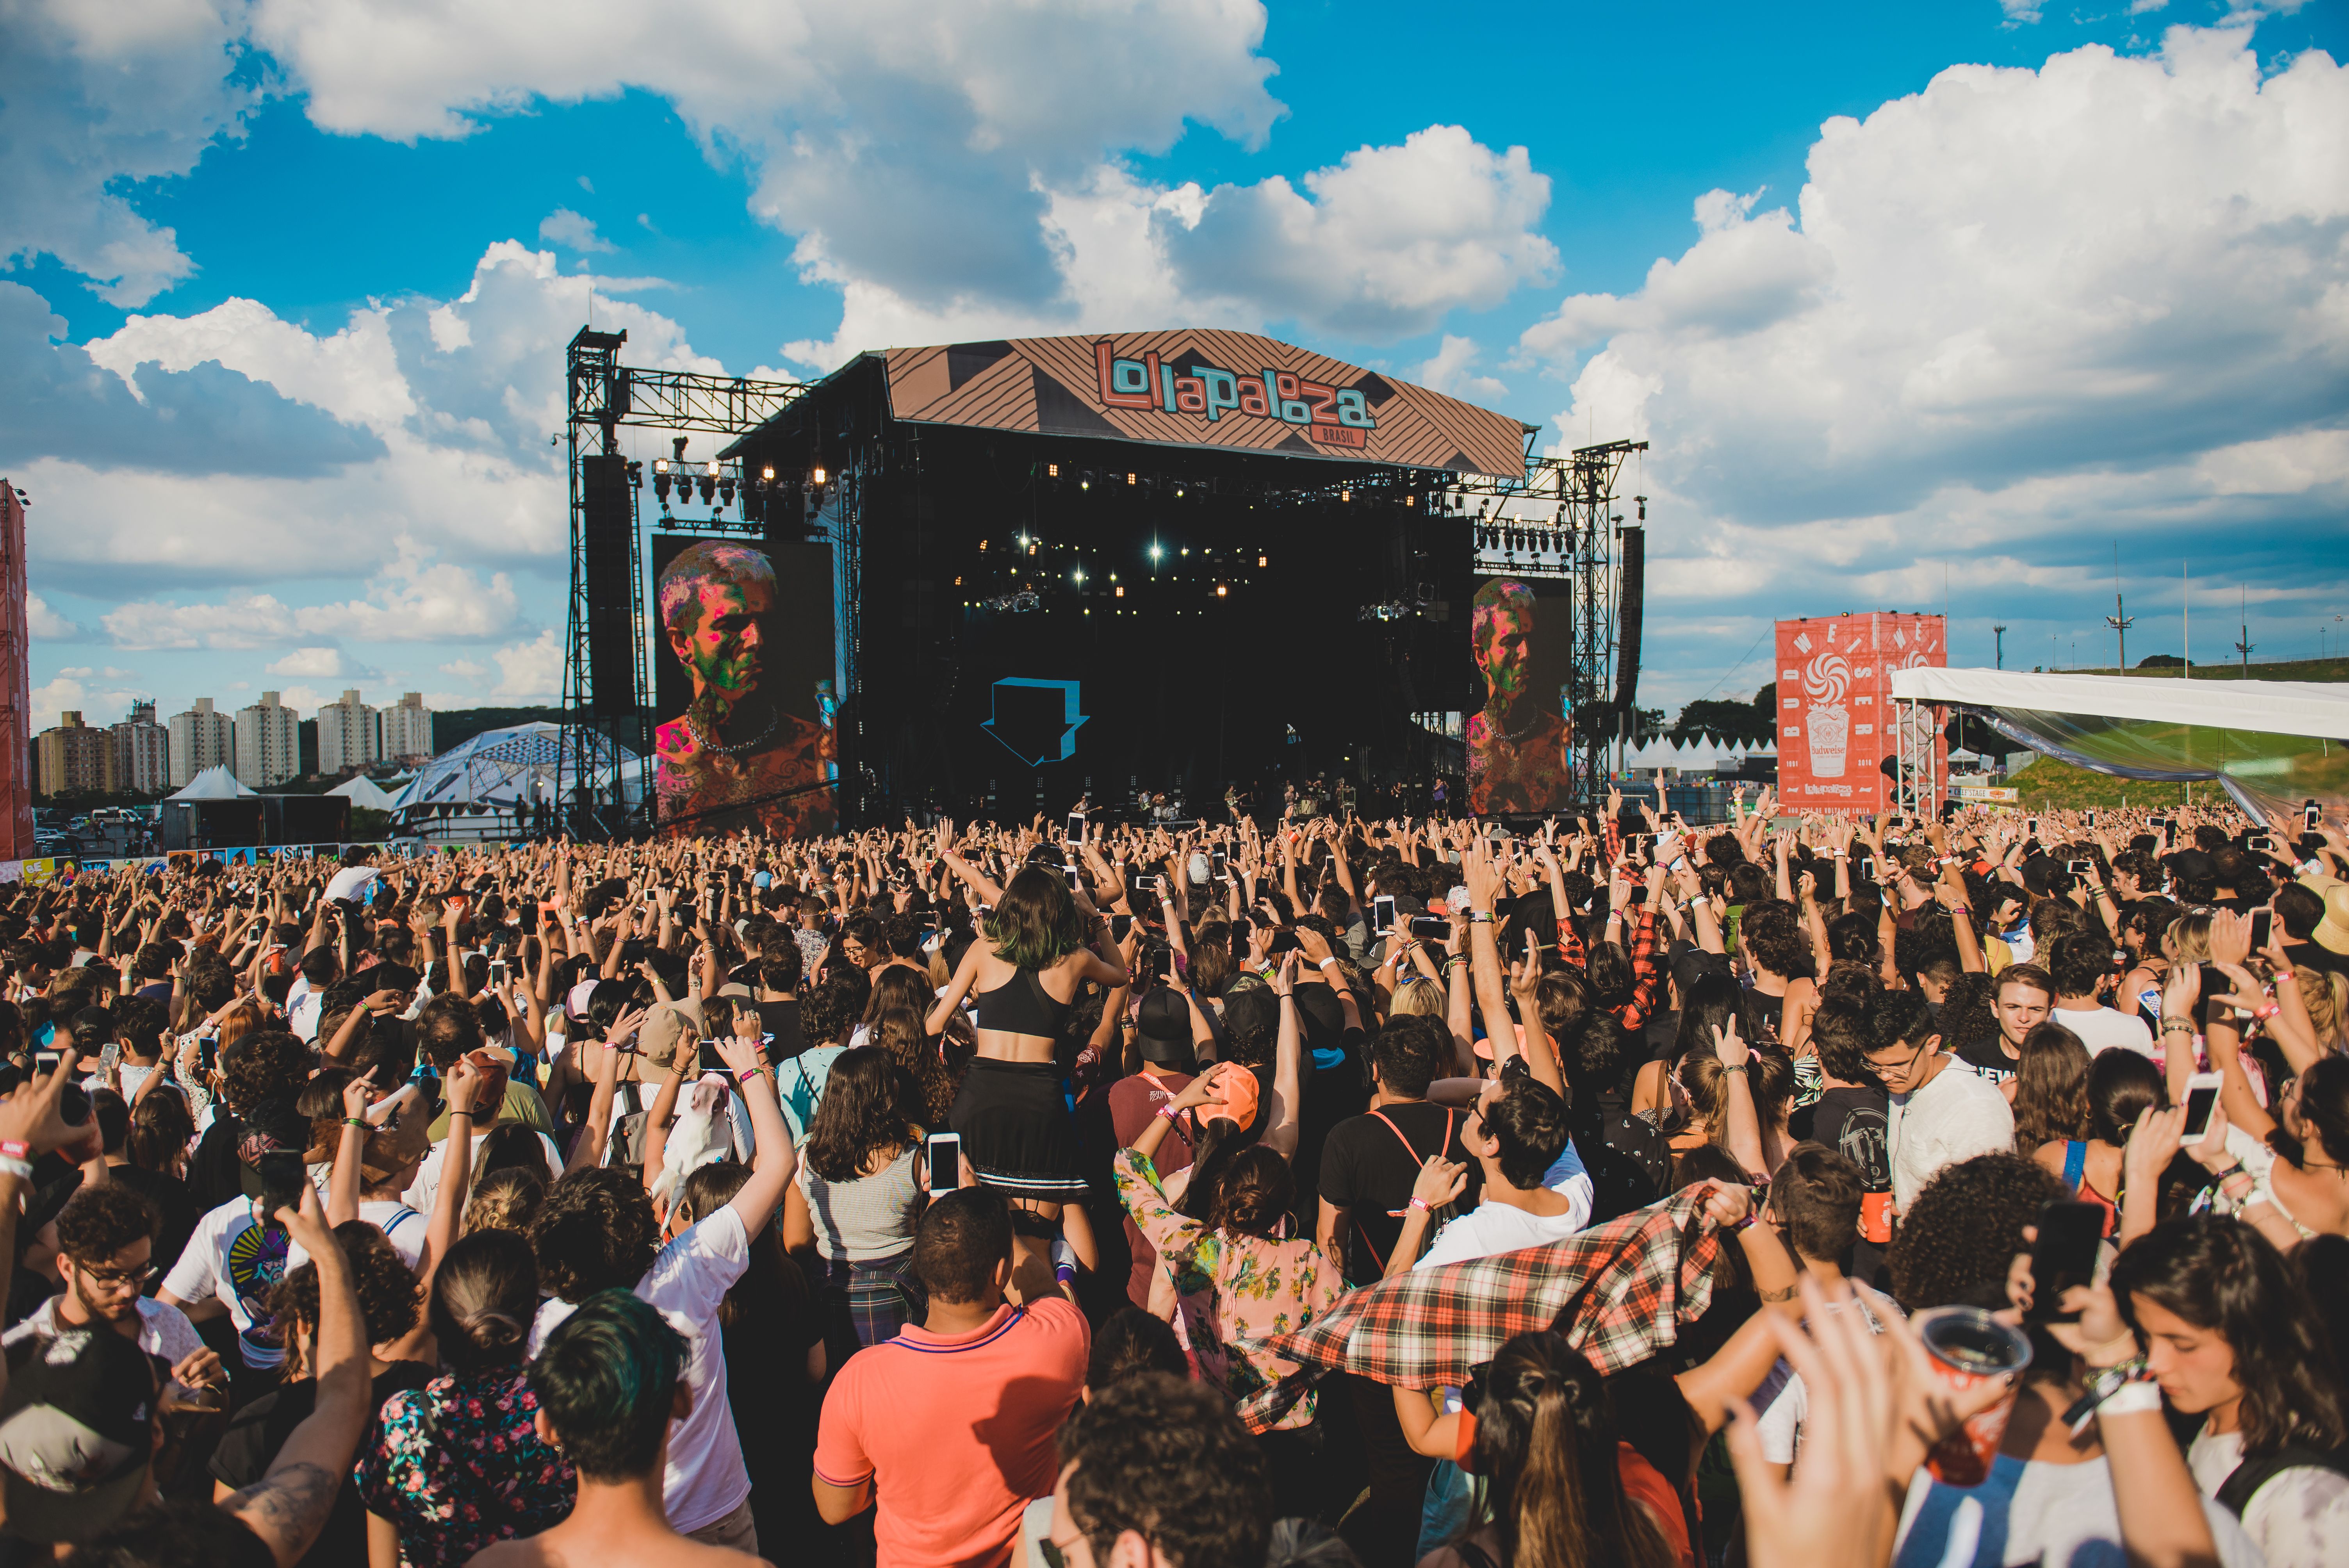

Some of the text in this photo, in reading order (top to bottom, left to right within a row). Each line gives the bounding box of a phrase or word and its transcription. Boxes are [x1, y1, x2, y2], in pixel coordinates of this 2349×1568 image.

[1096, 341, 1375, 429] Lollapalooza
[1322, 428, 1355, 444] BRASIL
[1812, 745, 1845, 754] Budweiser
[742, 1070, 753, 1080] PASS
